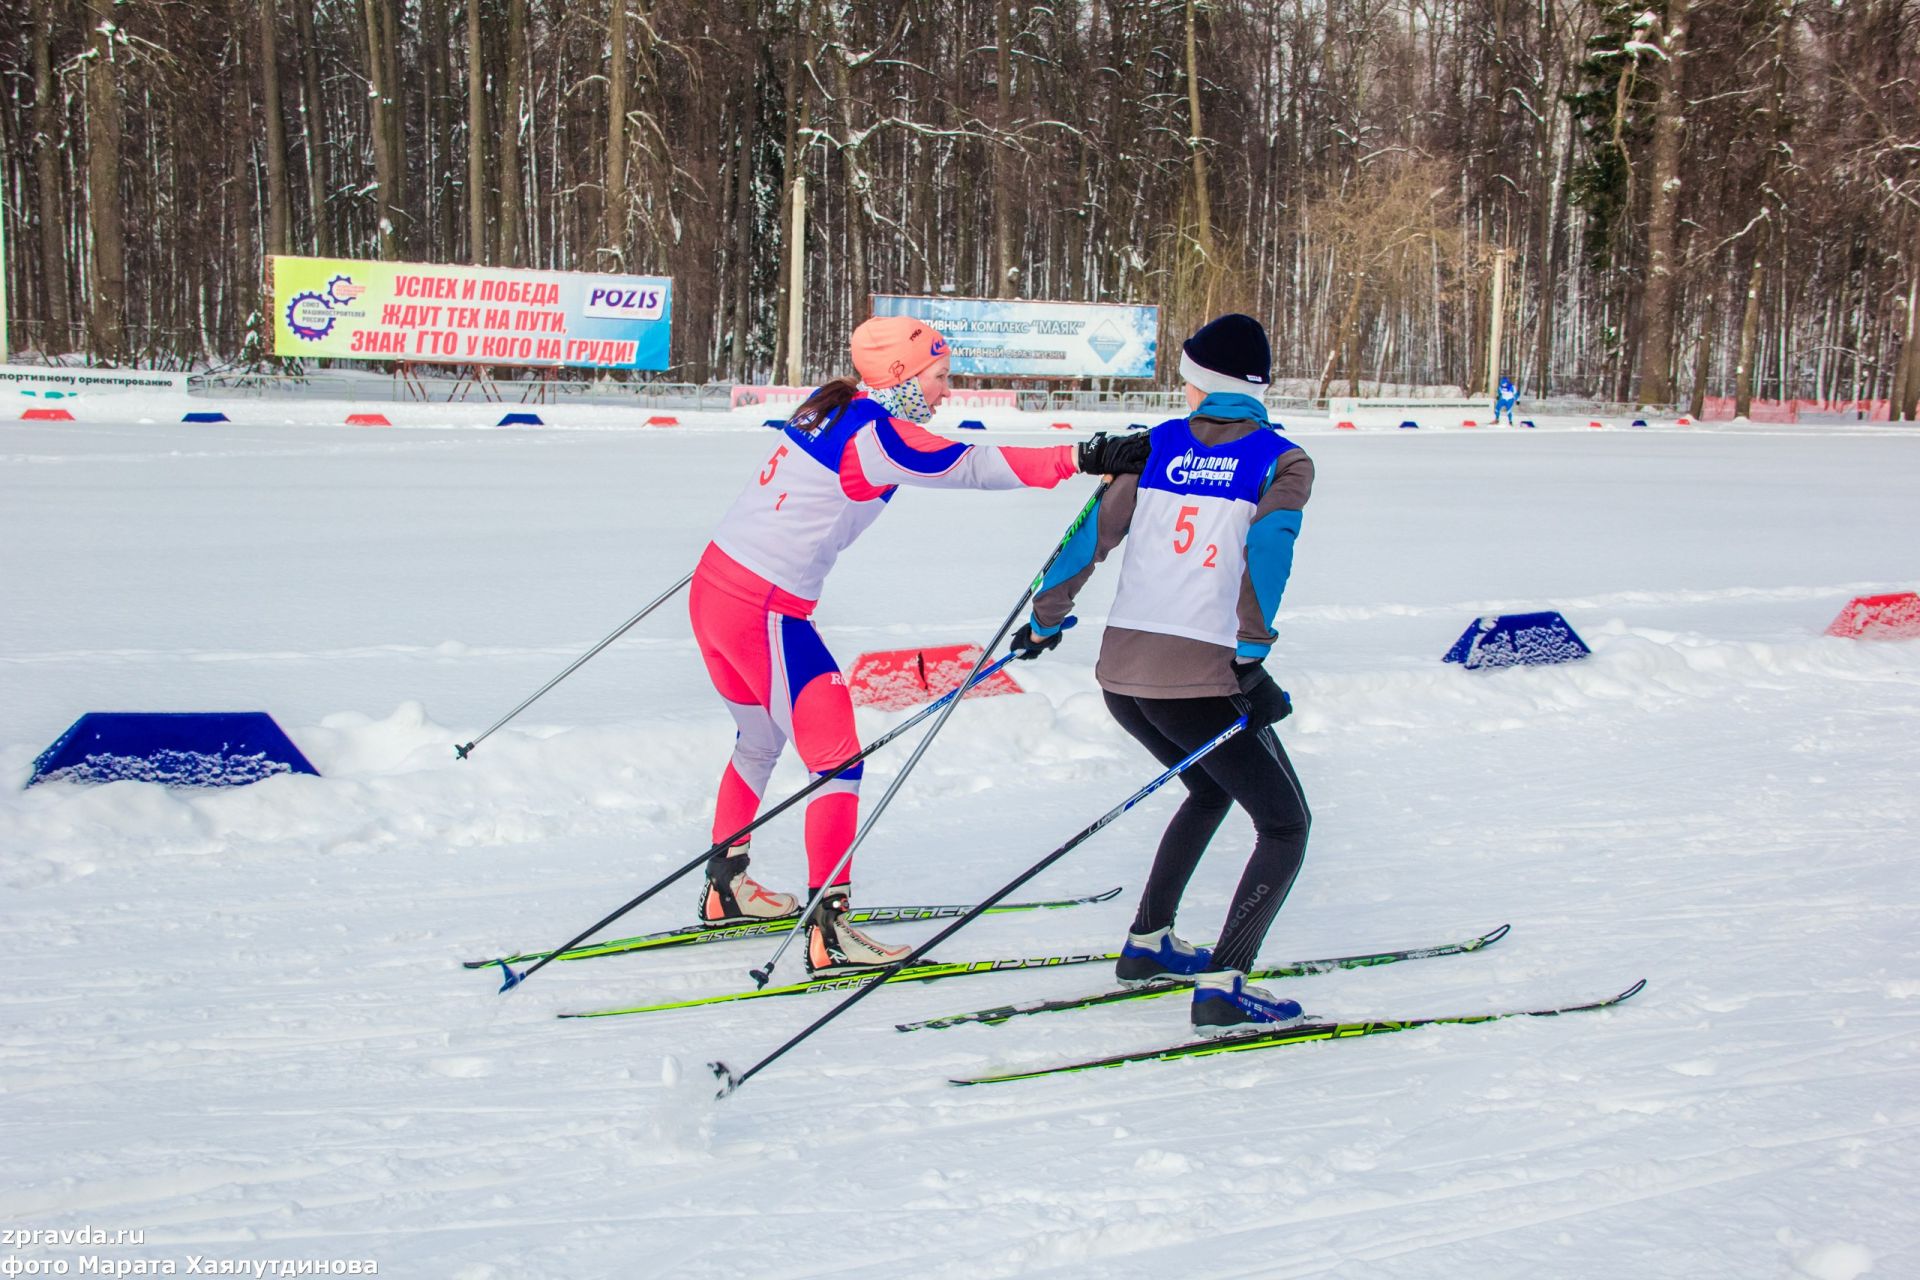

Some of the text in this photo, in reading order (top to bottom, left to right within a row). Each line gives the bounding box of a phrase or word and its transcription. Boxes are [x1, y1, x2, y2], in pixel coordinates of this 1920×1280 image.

[394, 275, 459, 299] УСПЕХ
[461, 279, 477, 300] И
[480, 280, 560, 307] ПОБЕДА
[590, 288, 659, 309] POZIS
[381, 304, 567, 334] ЖДУТ ТЕХ НА ПУТИ,
[970, 321, 1030, 334] КОМПЛЕКС
[350, 330, 408, 353] ЗНАК
[416, 331, 458, 355] ГТО
[482, 337, 532, 358] КОГО
[536, 339, 561, 360] НА
[566, 340, 635, 364] ГРУДИ!
[951, 345, 1005, 359] АКТИВНЫЙ
[78, 377, 173, 387] ориентированию
[759, 444, 789, 486] 5
[775, 493, 787, 511] 1
[1173, 506, 1199, 554] 5
[1203, 544, 1217, 568] 2
[695, 925, 770, 943] FISCHER
[806, 975, 880, 994] FISCHE
